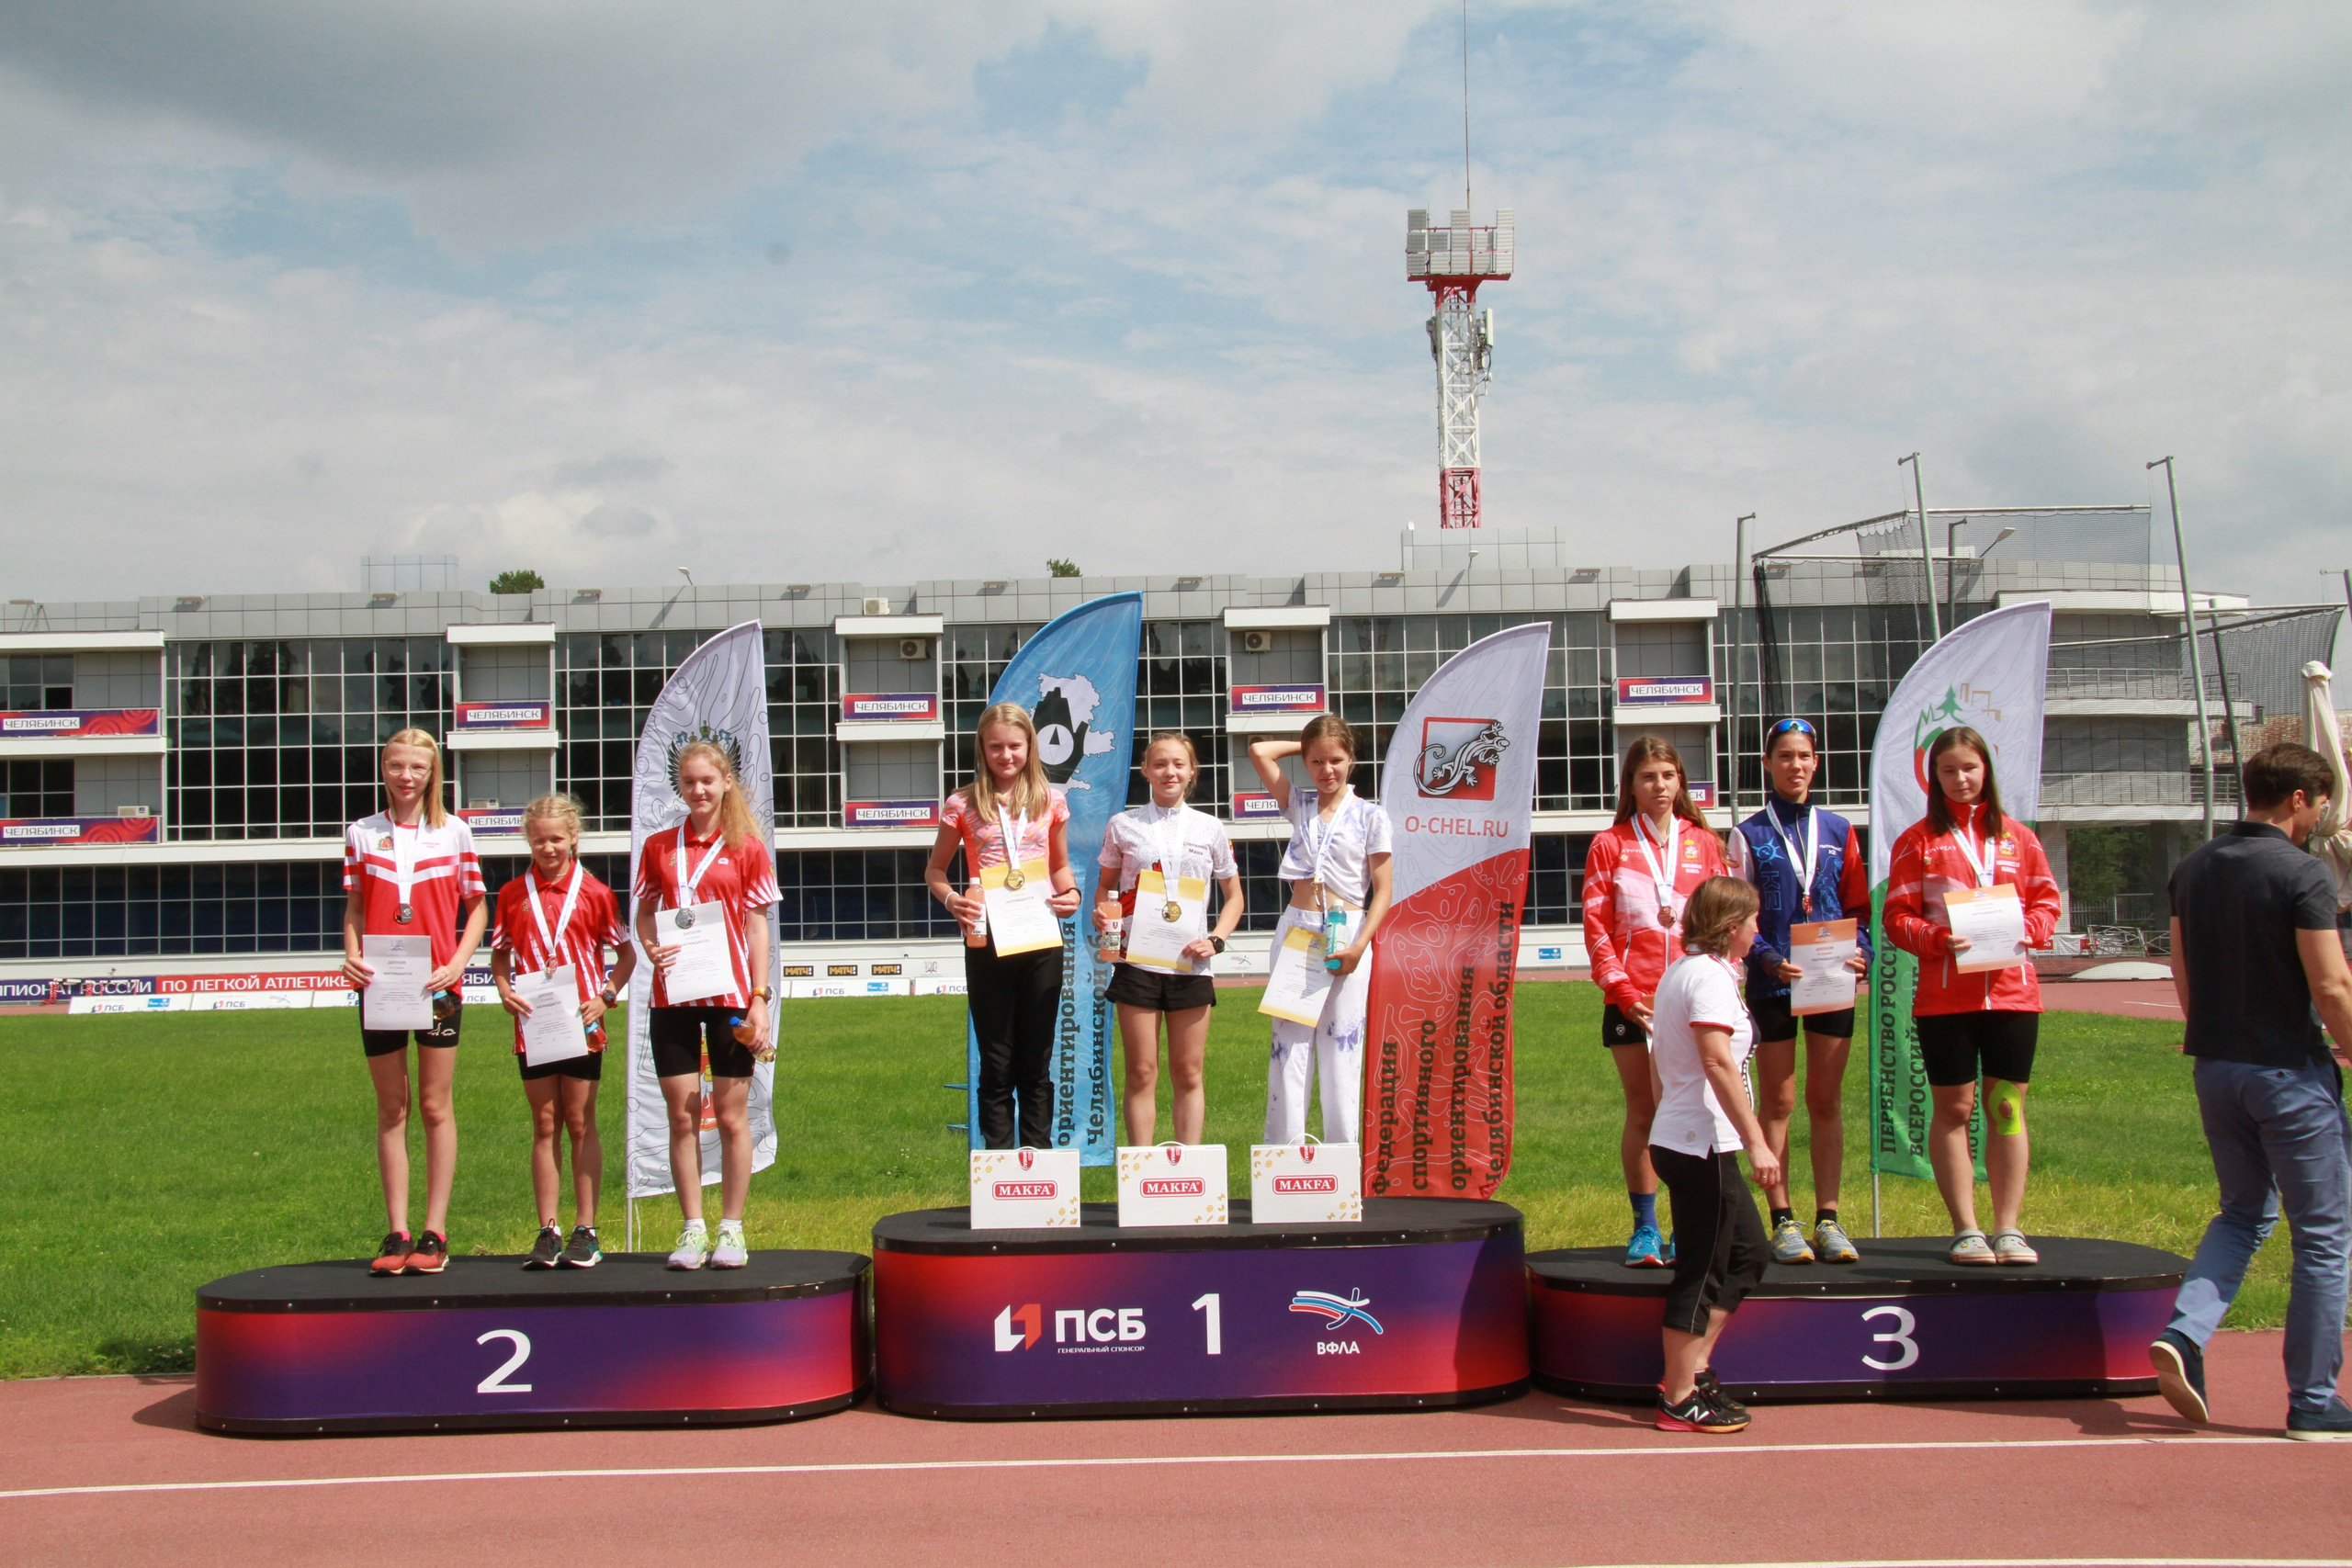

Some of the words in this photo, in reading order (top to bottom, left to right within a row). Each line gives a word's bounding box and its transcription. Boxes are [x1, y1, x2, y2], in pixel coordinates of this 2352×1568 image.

[1631, 685, 1702, 694] ЧЕЛЯБИНСК
[1244, 694, 1314, 703] ЧЕЛЯБИНСК
[856, 702, 926, 711] ЧЕЛЯБИНСК
[469, 710, 539, 719] ЧЕЛЯБИНСК
[5, 718, 78, 728] ЧЕЛЯБИНСК
[857, 809, 928, 818] ЧЕЛЯБИНСК
[469, 817, 523, 826] ЧЕЛЯБИН
[1405, 816, 1509, 838] O-CHEL.RU
[5, 826, 78, 836] ЧЕЛЯБИНСК
[1488, 901, 1515, 1010] области
[163, 979, 187, 992] ПО
[192, 975, 260, 992] ЛЕГКОЙ
[265, 975, 351, 989] АТЛЕТИКЕ
[1087, 967, 1108, 1146] Челябинской
[1450, 965, 1476, 1191] ориентирования
[1880, 1012, 1896, 1155] ПЕРВЕНСТВО
[1412, 1020, 1437, 1190] спортивного
[1373, 1041, 1399, 1194] Федерация
[999, 1185, 1051, 1196] MAKFA
[1147, 1182, 1199, 1193] MAKFA
[1279, 1179, 1331, 1190] MAKFA
[1055, 1308, 1147, 1342] ПСБ
[1192, 1293, 1221, 1355] 1
[1860, 1305, 1920, 1371] 3
[1057, 1346, 1110, 1354] ГЕНЕРАЛЬНЫЙ
[1317, 1341, 1360, 1355] ВФЛА
[476, 1328, 533, 1393] 2
